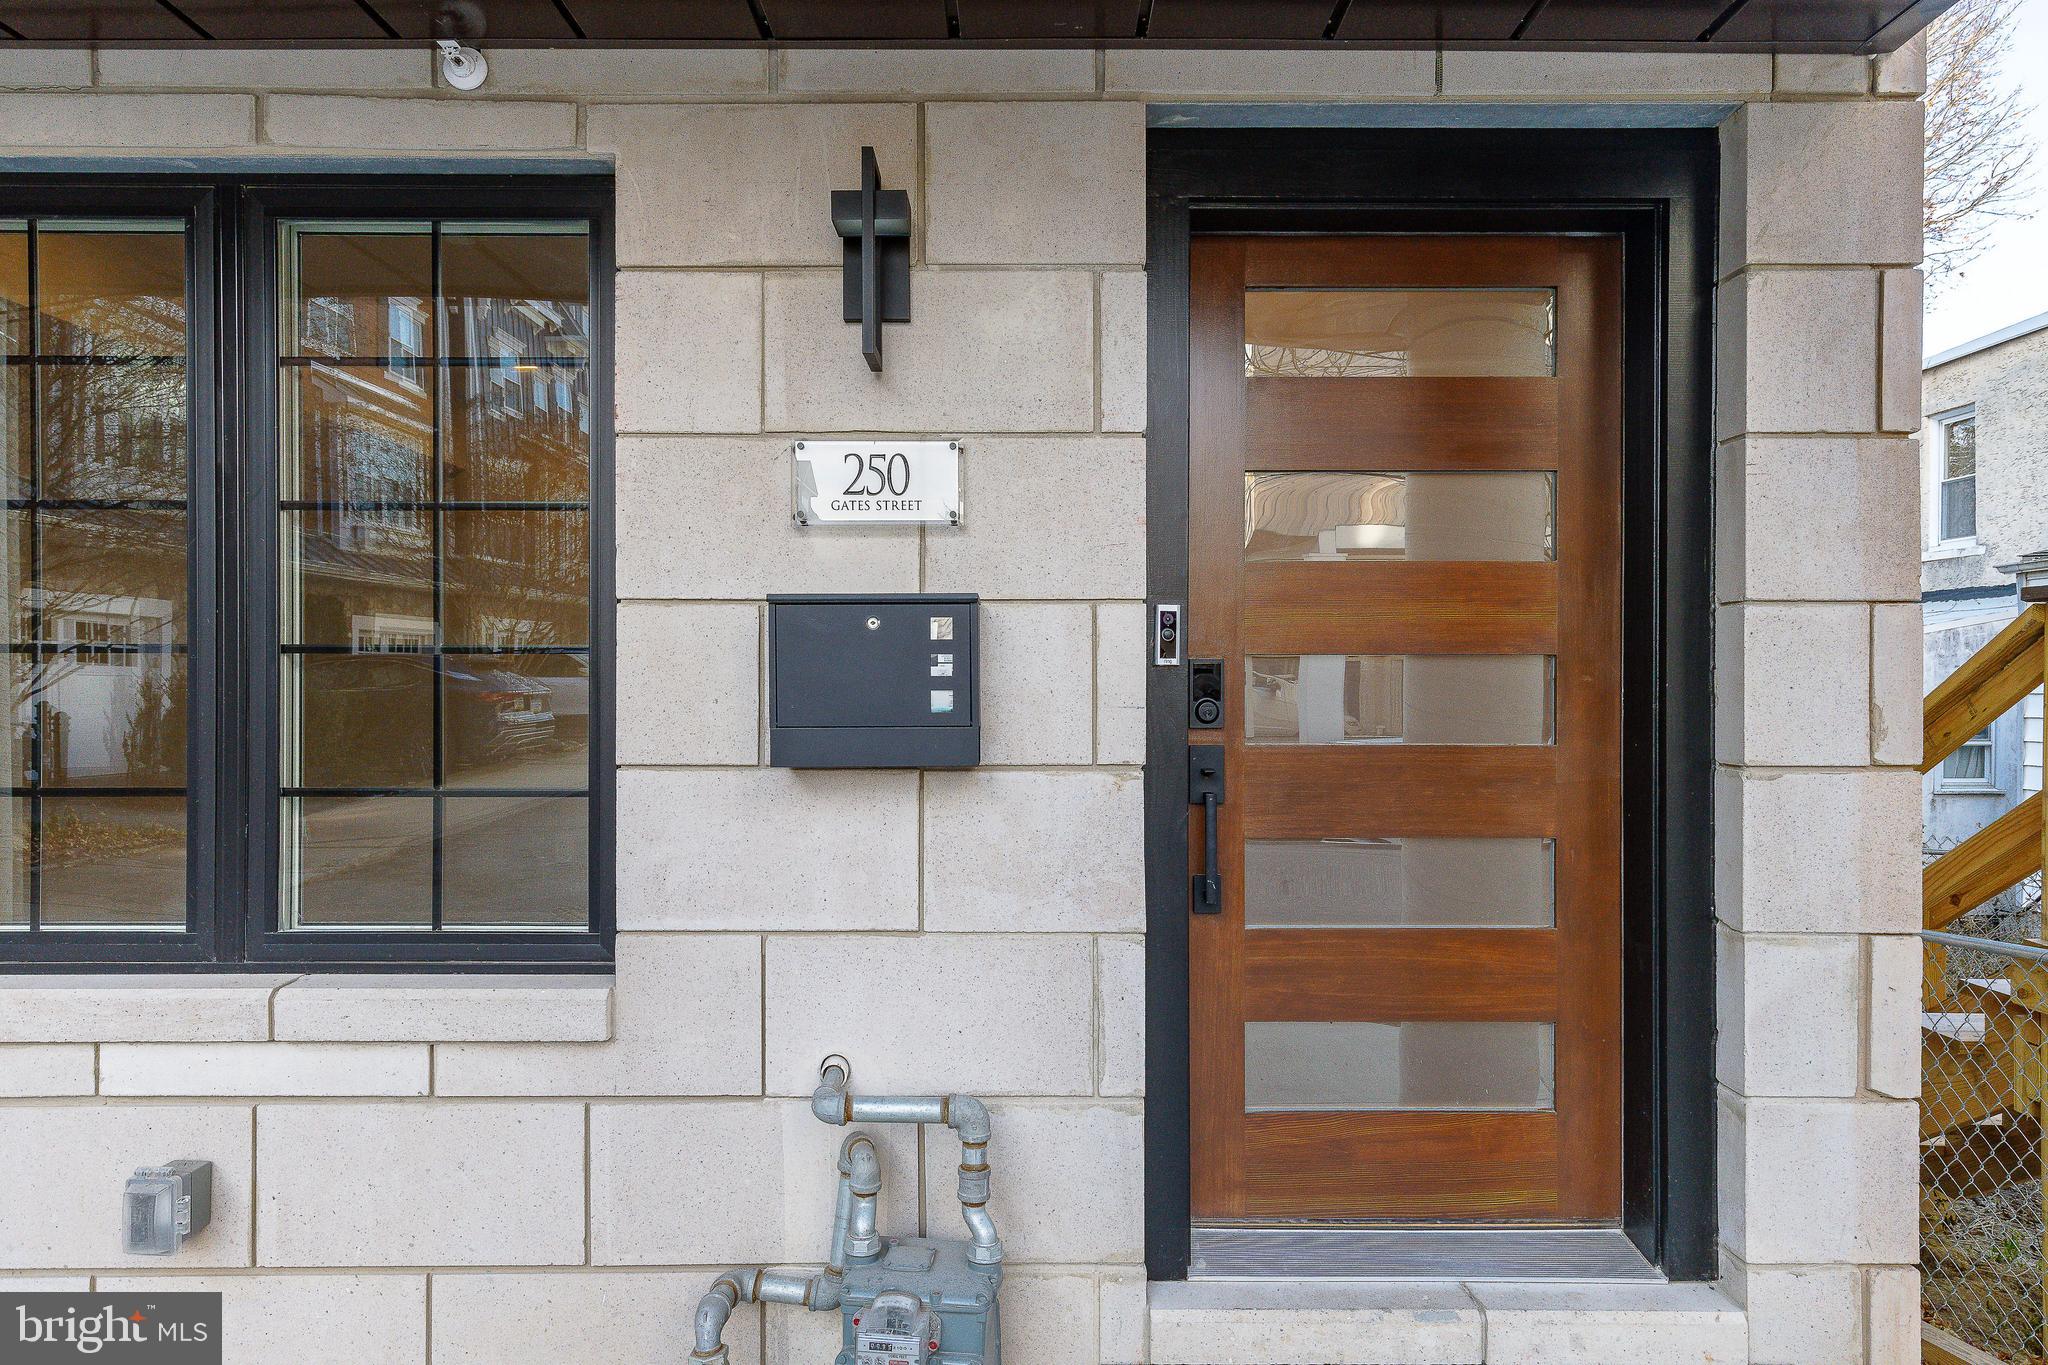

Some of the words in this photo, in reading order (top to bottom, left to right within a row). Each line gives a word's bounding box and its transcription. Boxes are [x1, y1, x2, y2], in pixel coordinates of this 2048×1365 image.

[842, 452, 911, 497] 250
[831, 500, 871, 511] GATES
[876, 500, 922, 511] STREET
